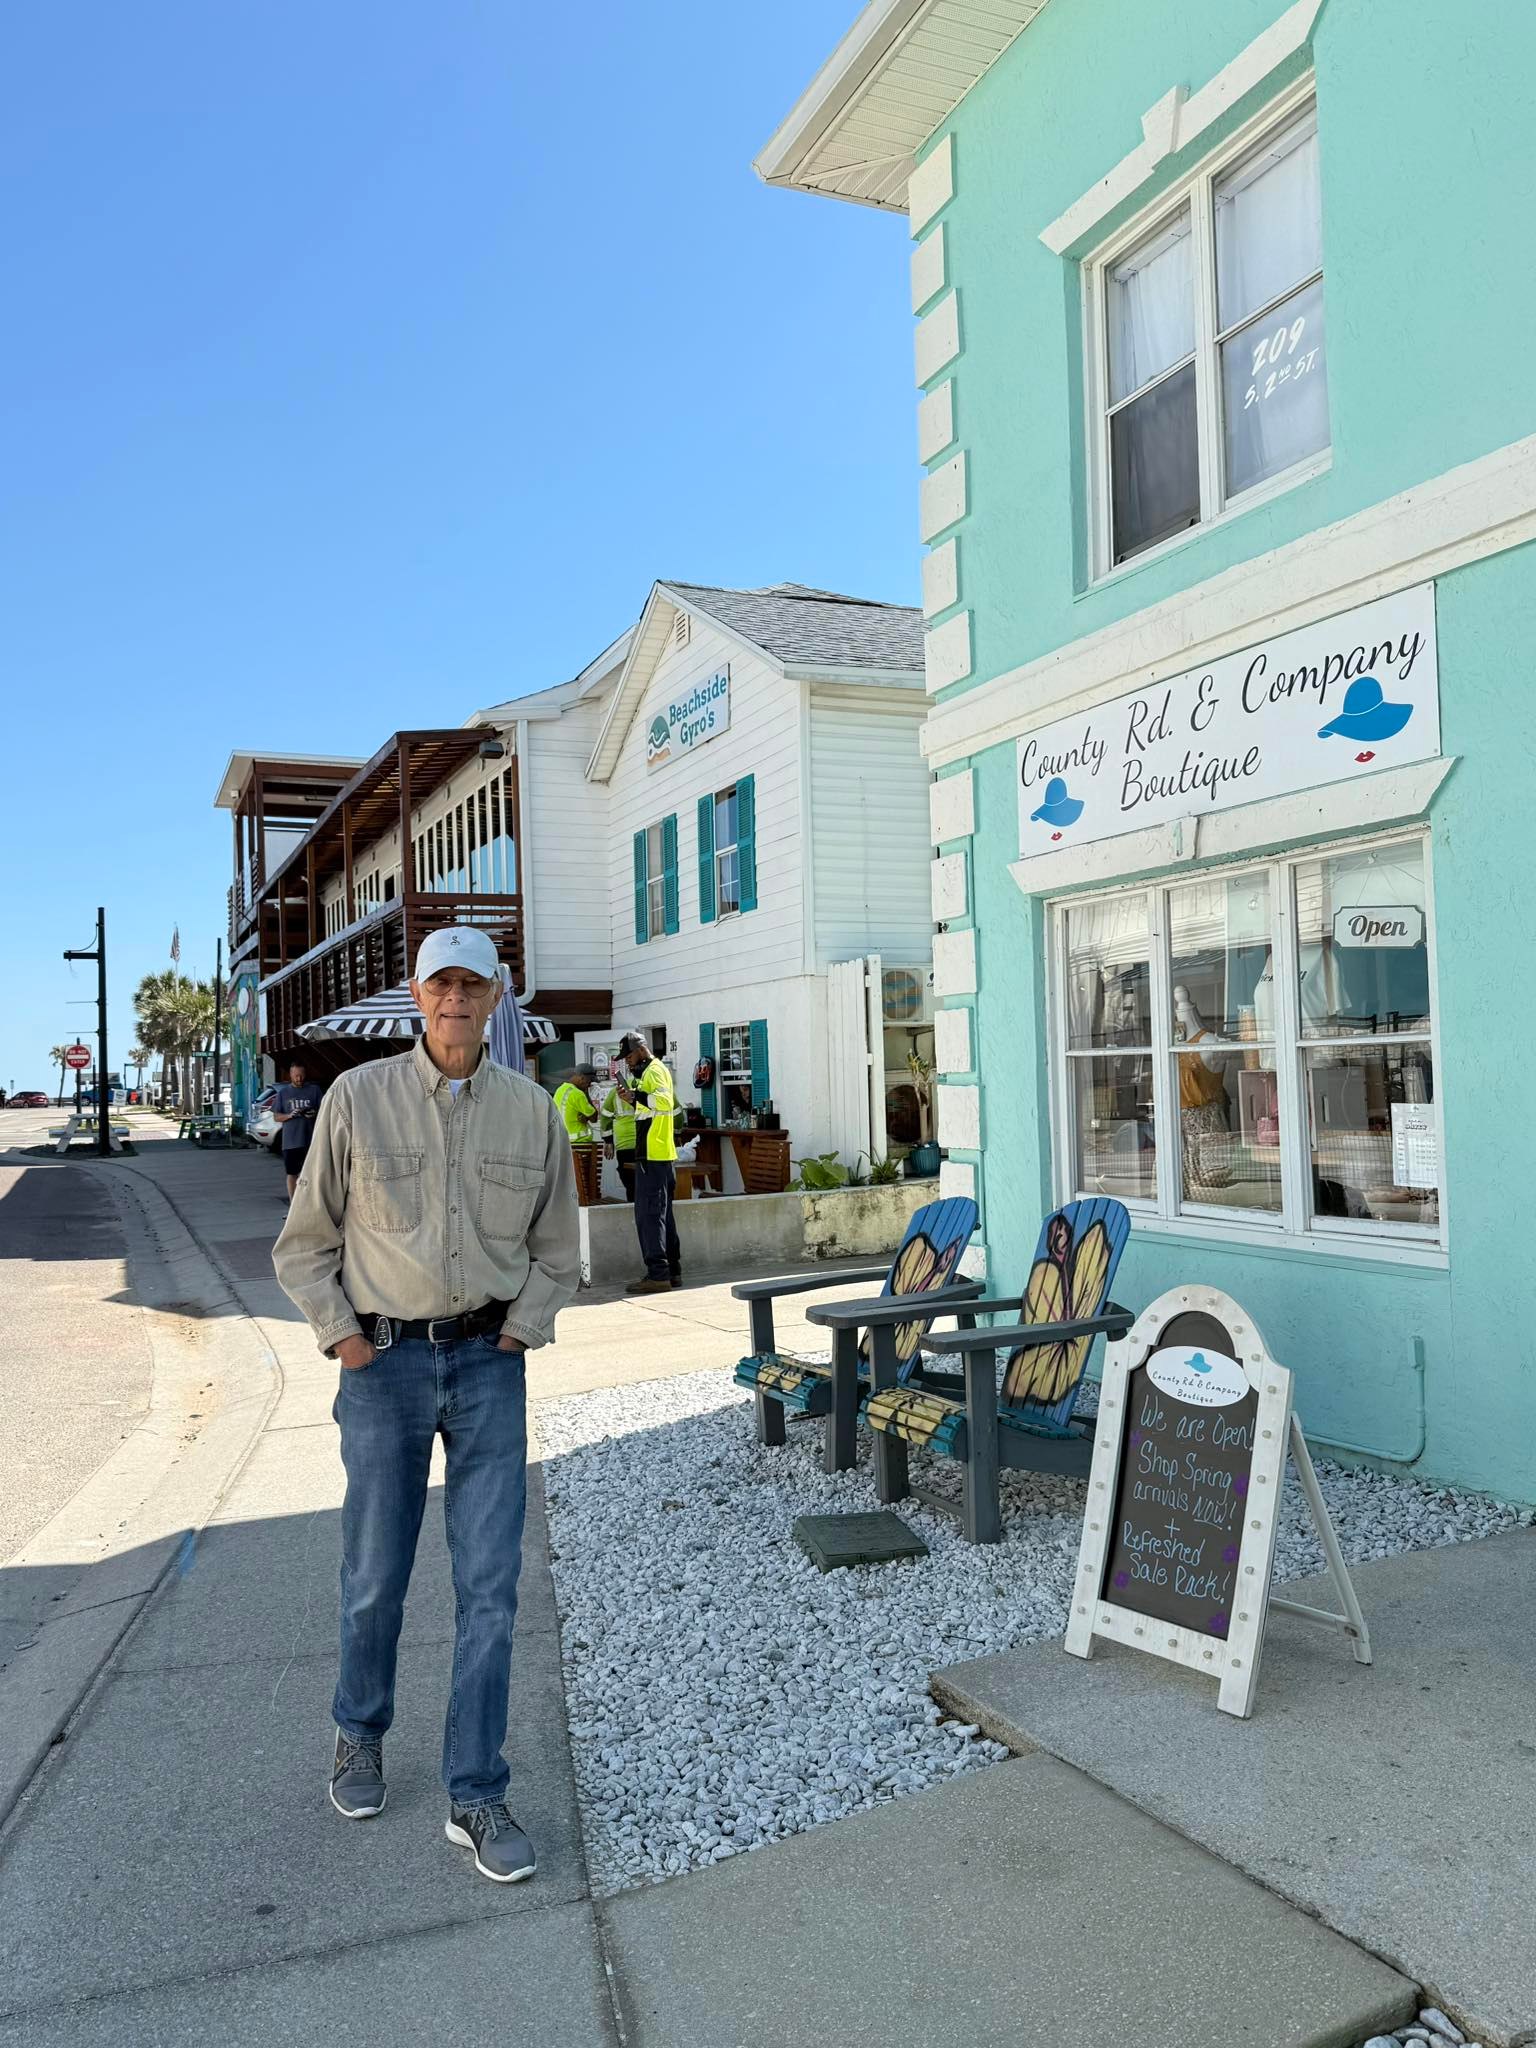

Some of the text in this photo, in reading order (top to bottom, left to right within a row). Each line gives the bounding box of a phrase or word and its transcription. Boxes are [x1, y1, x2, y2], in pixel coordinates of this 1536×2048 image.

[1252, 316, 1305, 376] 209
[668, 674, 727, 727] Beachside
[680, 706, 715, 747] Gyro's
[1021, 632, 1426, 787] County Rd. & Company
[1120, 746, 1262, 812] Boutique
[1347, 914, 1408, 943] Open
[1152, 1371, 1180, 1385] County
[1205, 1381, 1242, 1397] Company
[1177, 1388, 1214, 1403] Boutique
[1140, 1394, 1255, 1452] We are Open!
[1138, 1440, 1233, 1506] Shop Spring
[1133, 1480, 1237, 1531] arrivals NOW!
[1123, 1520, 1206, 1567] Refreshed
[1129, 1552, 1231, 1604] Sale Rack!
